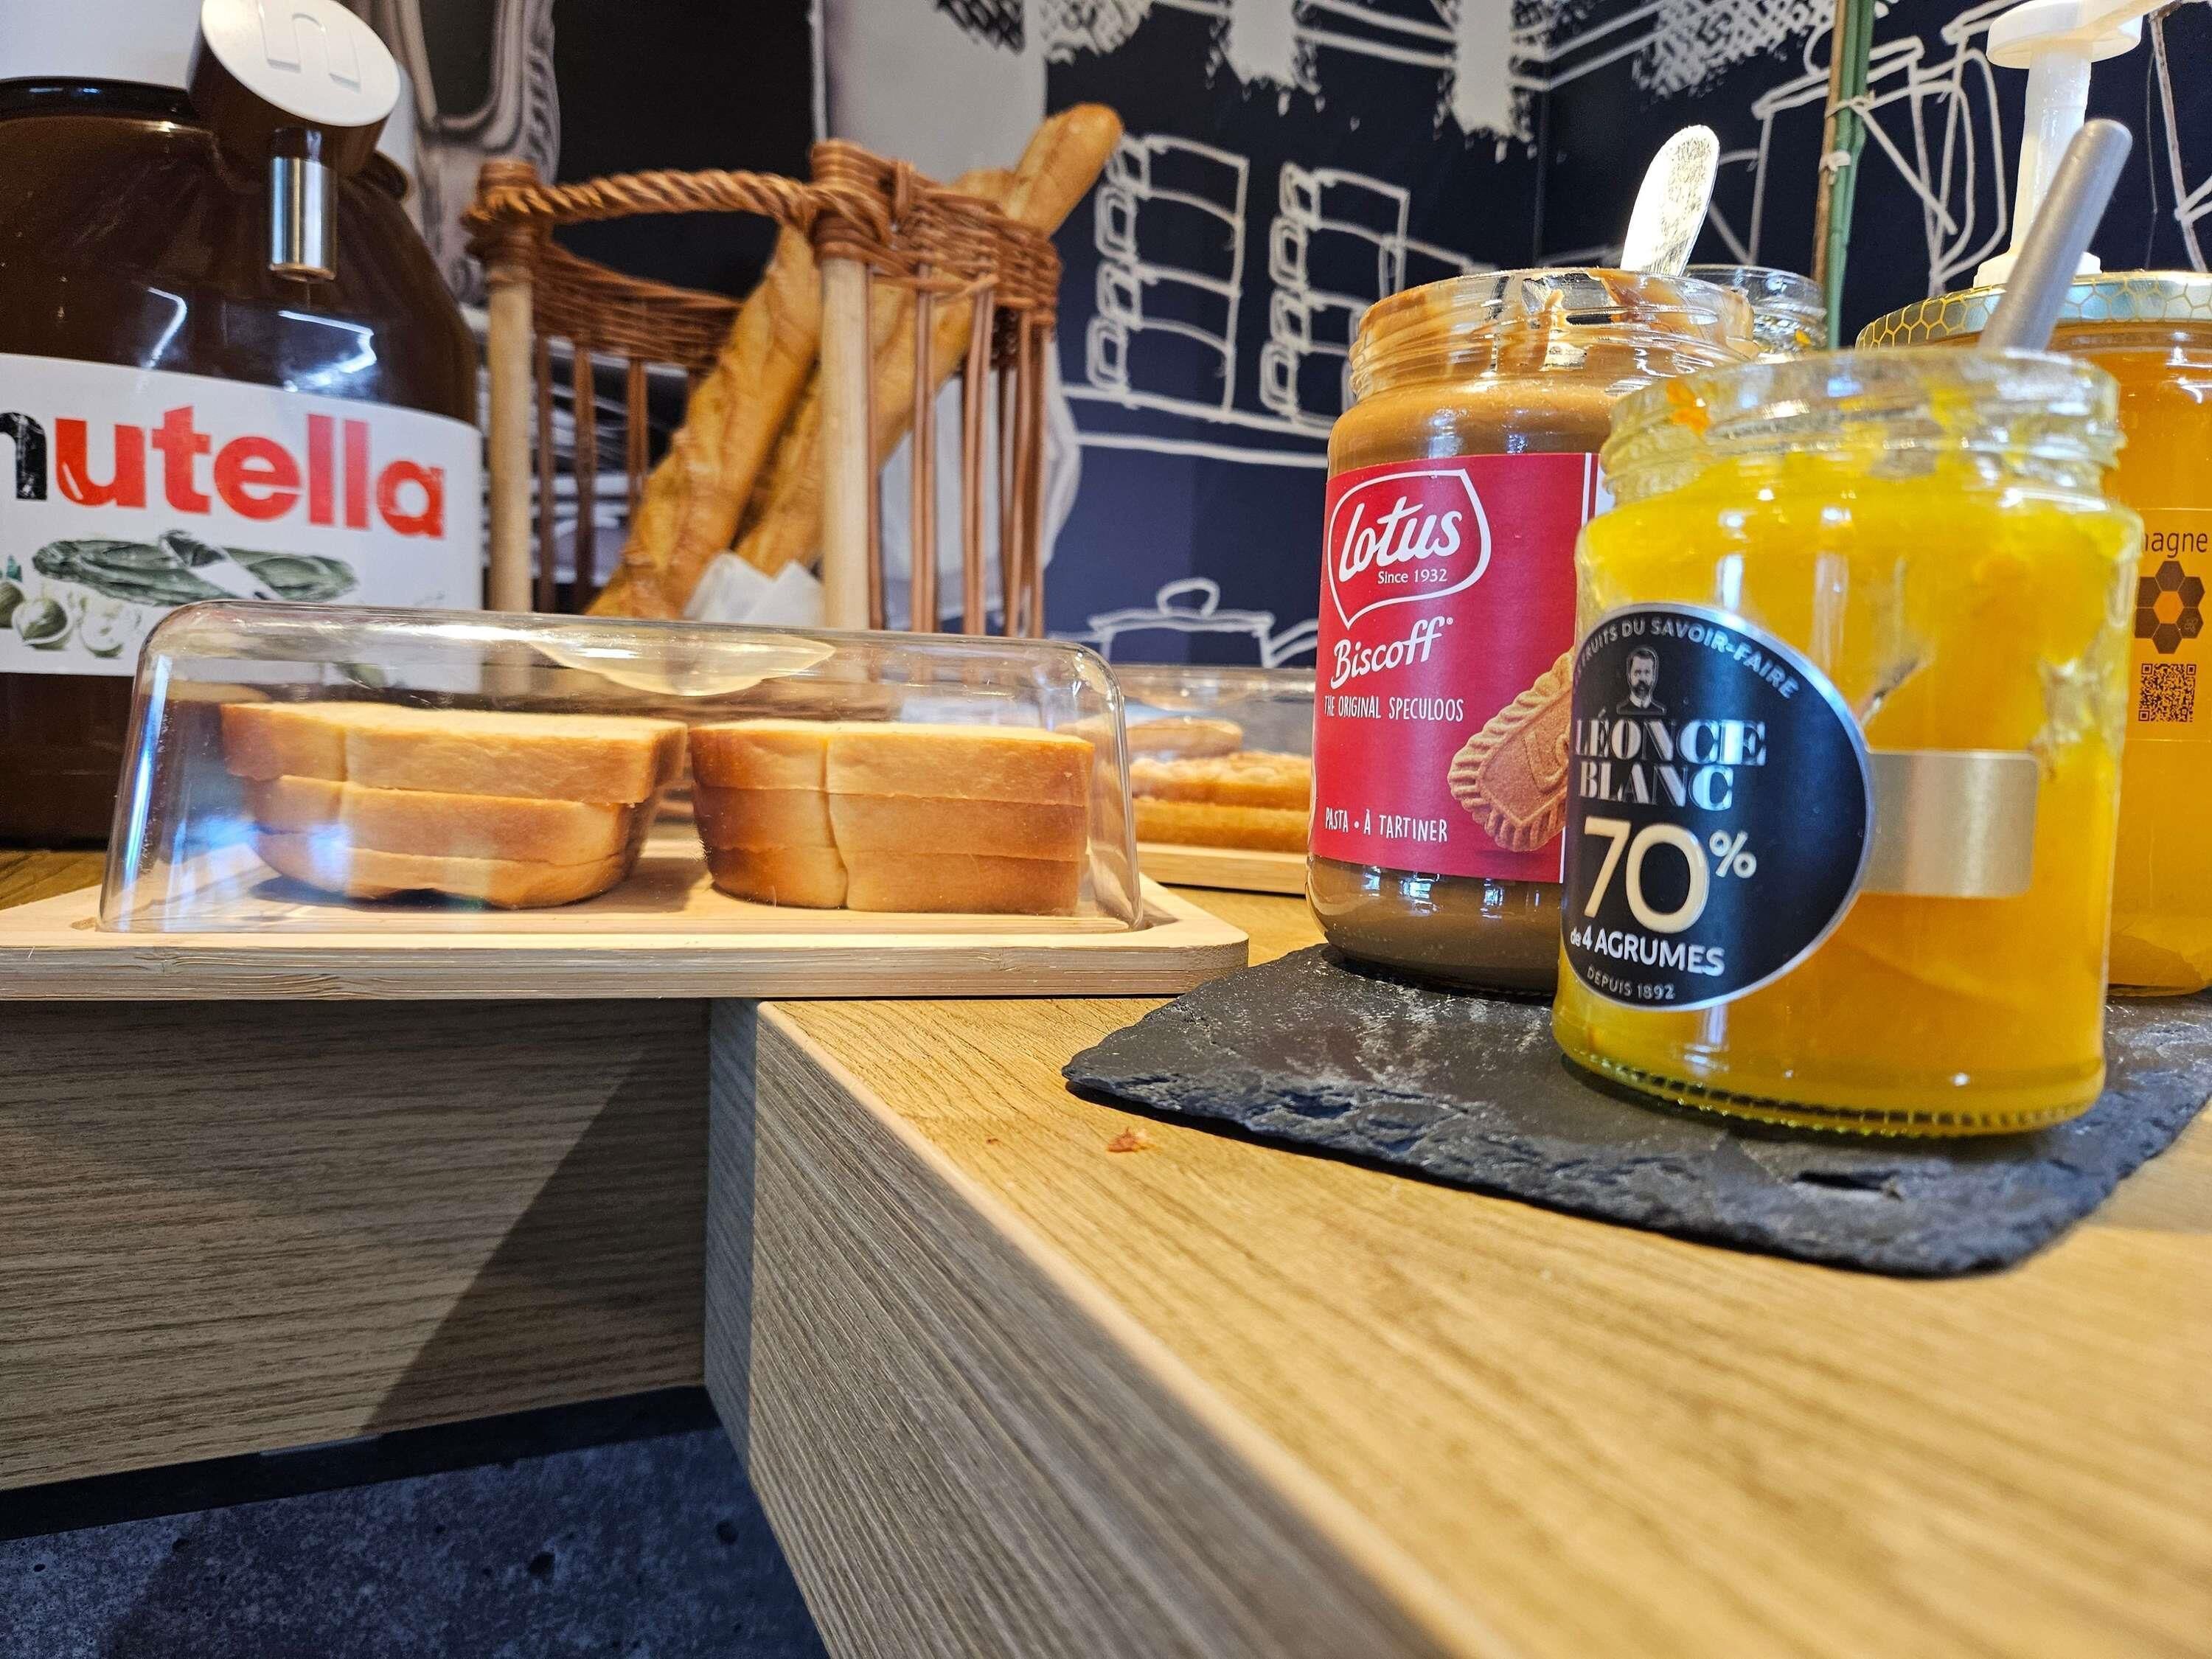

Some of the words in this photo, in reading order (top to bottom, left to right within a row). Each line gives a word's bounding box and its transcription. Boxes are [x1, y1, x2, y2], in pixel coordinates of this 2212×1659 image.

[1377, 571, 1408, 584] Since
[1414, 568, 1447, 582] 1932
[1621, 618, 1646, 638] DU
[1650, 617, 1799, 699] SAVOIR-FAIRE
[1324, 695, 1335, 717] THE
[1338, 695, 1381, 719] ORIGINAL
[1388, 697, 1464, 722] SPECULOOS
[1576, 706, 1766, 765] LÉONCE
[1579, 760, 1733, 811] BLANC
[1325, 807, 1349, 832] PASTA
[1363, 808, 1371, 835] À
[1379, 814, 1447, 843] TARTINER
[1570, 926, 1582, 947] de
[1582, 925, 1593, 950] 4
[1593, 928, 1725, 977] AGRUMES
[1587, 965, 1633, 997] DEPUIS
[1637, 983, 1676, 1001] 1892
